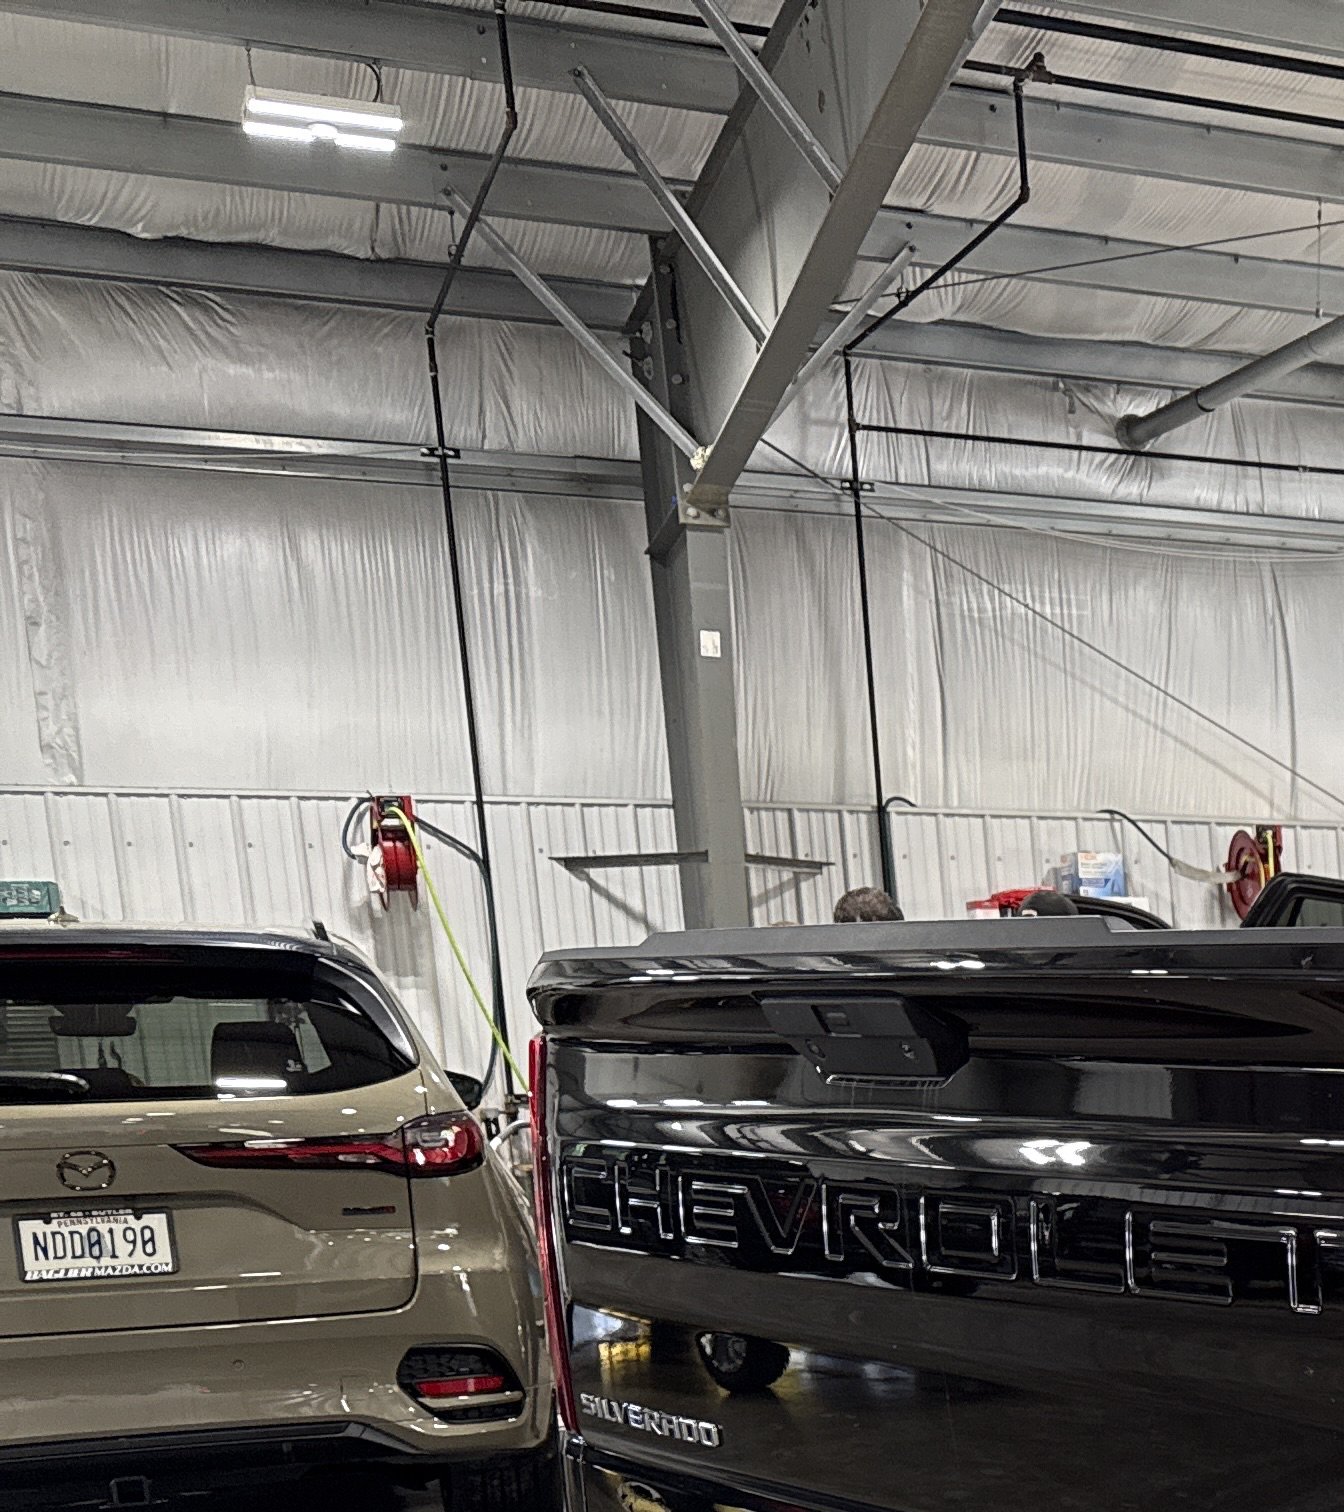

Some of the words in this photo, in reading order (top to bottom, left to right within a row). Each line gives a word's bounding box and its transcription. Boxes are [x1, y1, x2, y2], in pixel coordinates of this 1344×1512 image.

[57, 1216, 129, 1228] PENNSYLVANIA
[32, 1225, 157, 1262] NDD0190
[580, 1392, 723, 1448] SILVERADO
